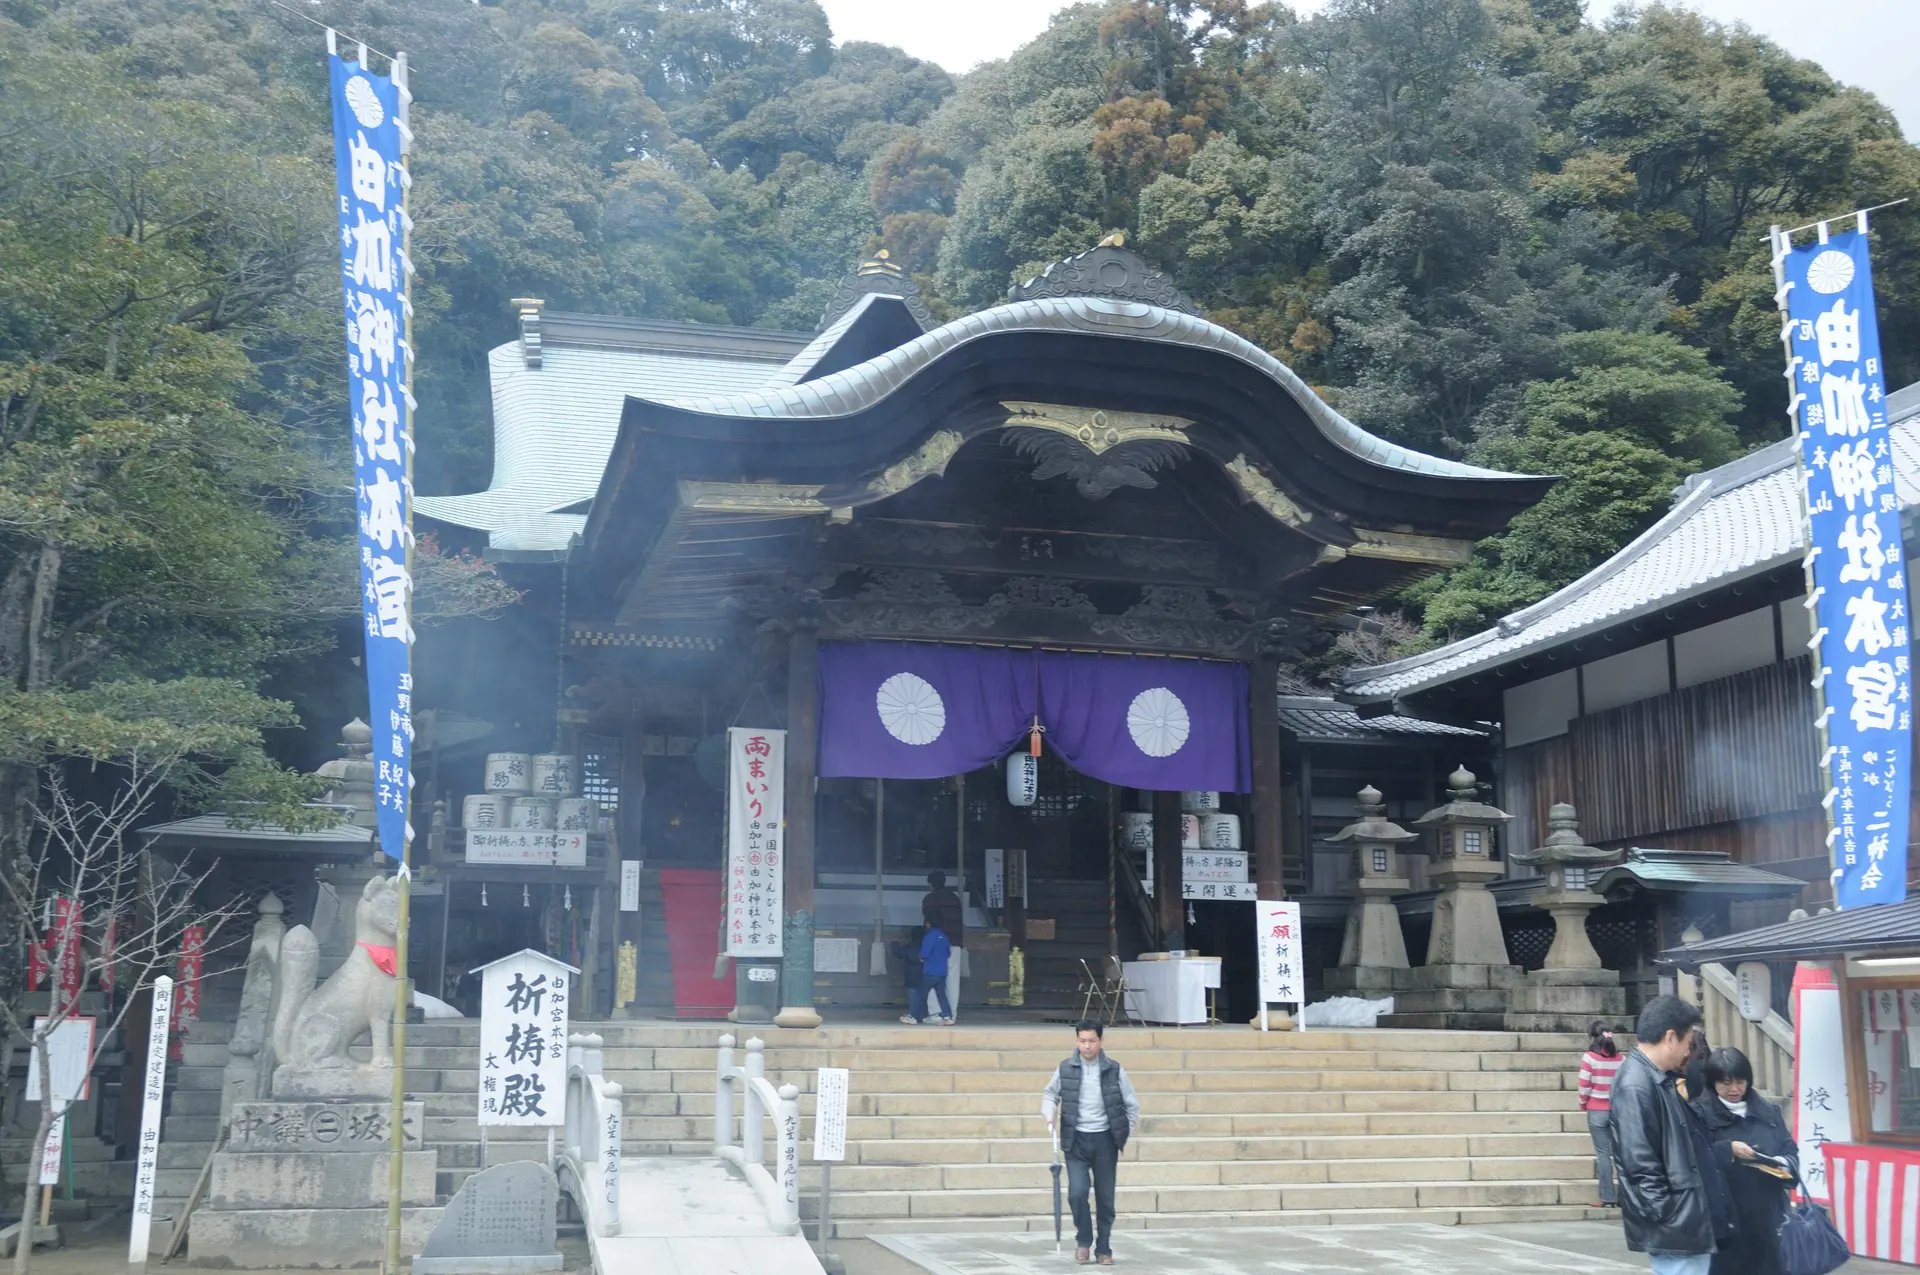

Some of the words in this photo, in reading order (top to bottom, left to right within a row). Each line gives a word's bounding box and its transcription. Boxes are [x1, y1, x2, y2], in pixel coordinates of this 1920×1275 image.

[348, 129, 407, 643] 由加神社本宮
[378, 760, 392, 805] 民子
[744, 736, 771, 818] 両まいり
